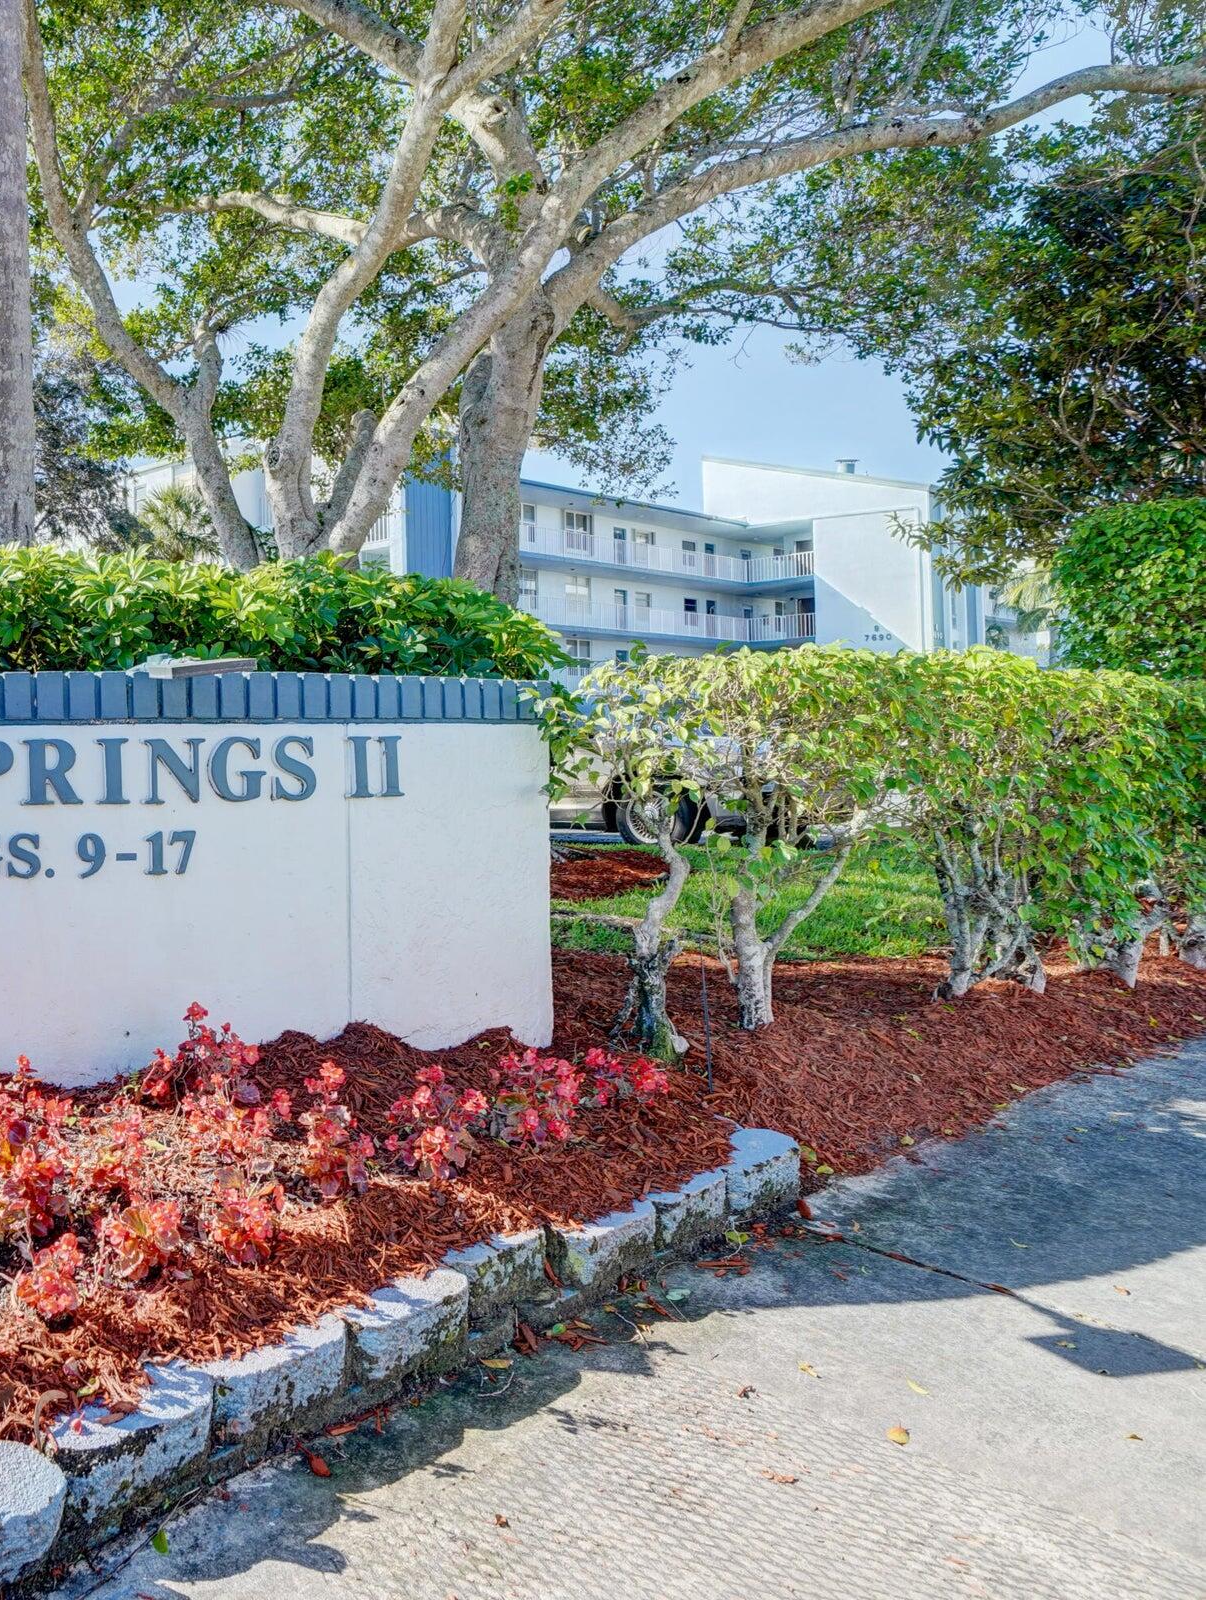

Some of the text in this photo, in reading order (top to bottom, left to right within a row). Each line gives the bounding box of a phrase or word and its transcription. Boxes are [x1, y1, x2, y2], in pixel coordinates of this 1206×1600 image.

[864, 633, 892, 641] 7690
[345, 735, 406, 799] II
[76, 830, 197, 879] 9-17
